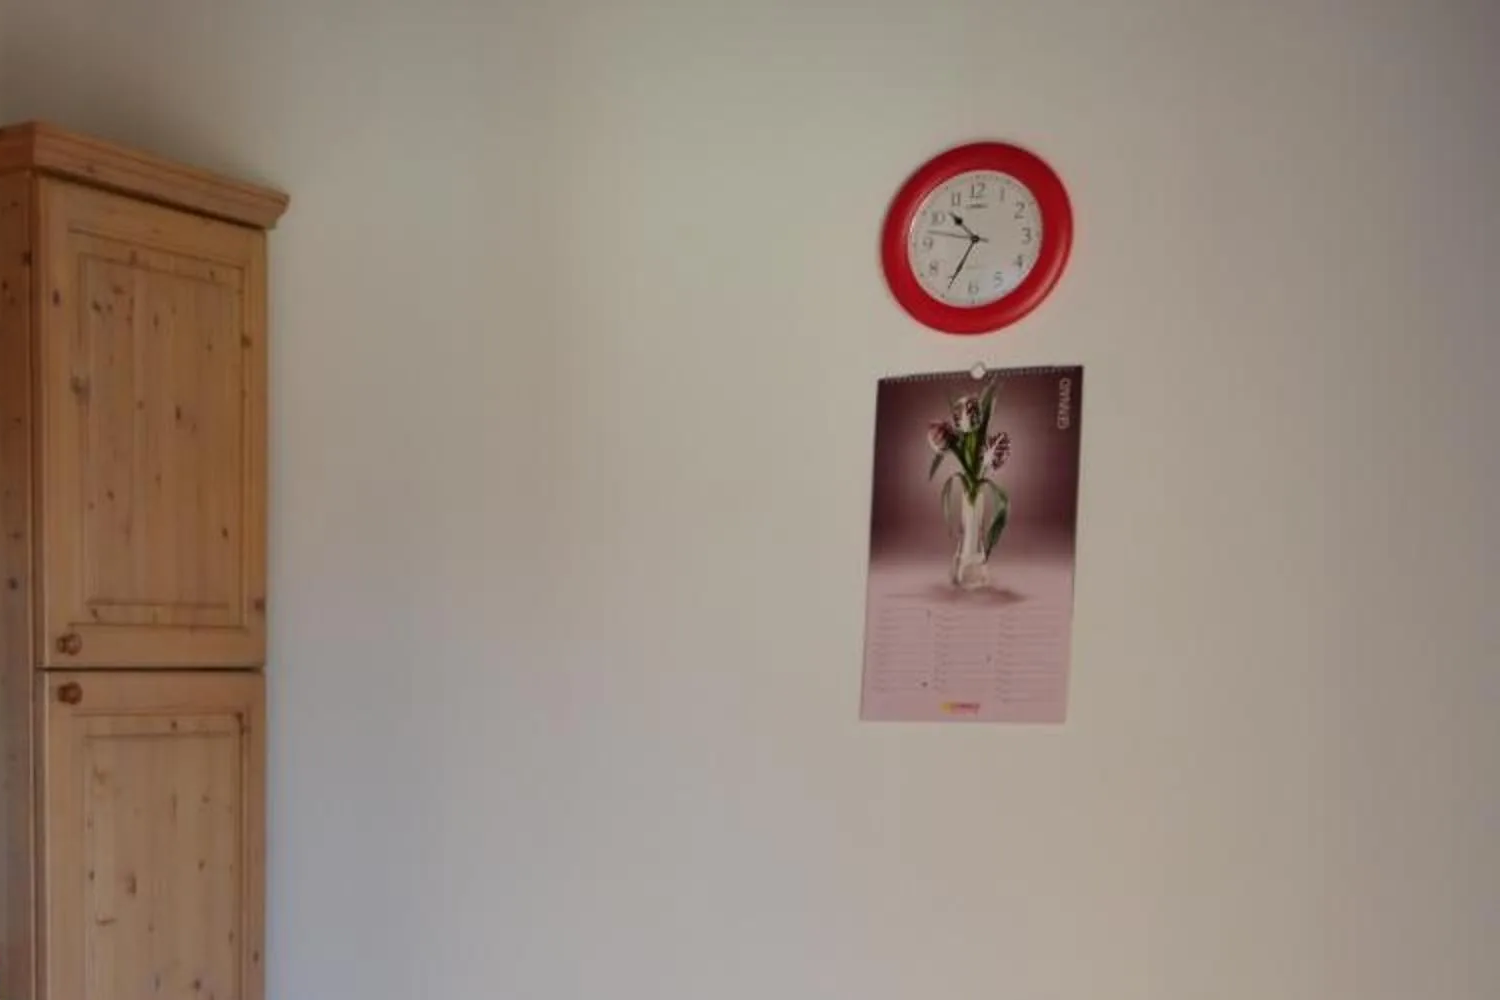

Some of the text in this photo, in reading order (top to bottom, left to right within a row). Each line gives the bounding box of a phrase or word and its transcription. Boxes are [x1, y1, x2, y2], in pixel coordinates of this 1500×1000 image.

[969, 182, 986, 199] 12
[951, 192, 961, 206] 11
[1014, 201, 1026, 219] 2
[931, 213, 946, 225] 10
[922, 237, 934, 249] 9
[1021, 227, 1032, 245] 3
[1013, 255, 1023, 268] 4
[993, 271, 1004, 288] 5
[968, 281, 979, 295] 6
